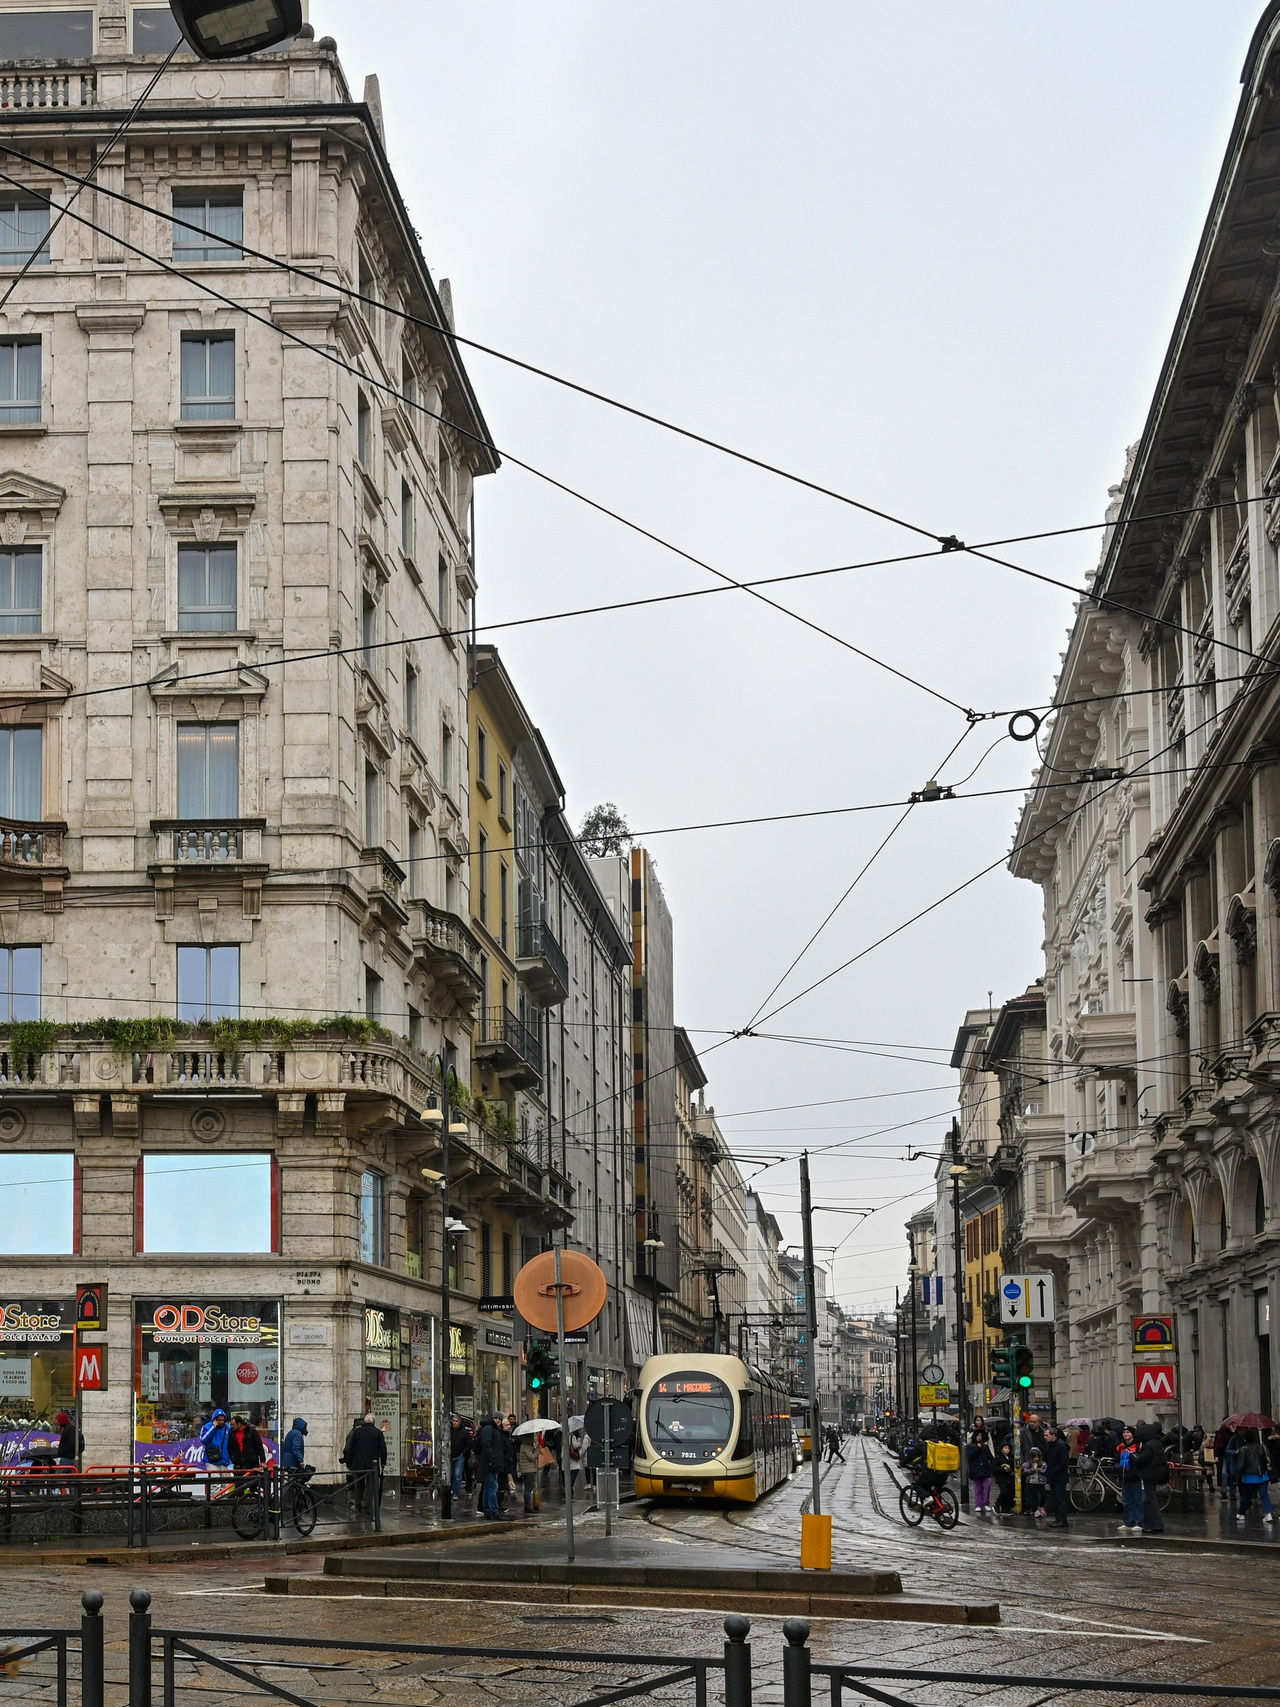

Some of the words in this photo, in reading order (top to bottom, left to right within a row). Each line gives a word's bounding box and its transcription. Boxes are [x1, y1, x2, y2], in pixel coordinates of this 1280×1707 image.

[153, 1305, 259, 1331] ODStore
[153, 1335, 196, 1343] OVUNQUE
[198, 1335, 226, 1343] DOLCE
[227, 1335, 260, 1343] SALATO
[79, 1355, 100, 1380] M
[658, 1383, 667, 1393] 14
[676, 1384, 682, 1392] C.
[683, 1383, 711, 1392] MAGGIORE
[1139, 1372, 1172, 1393] M
